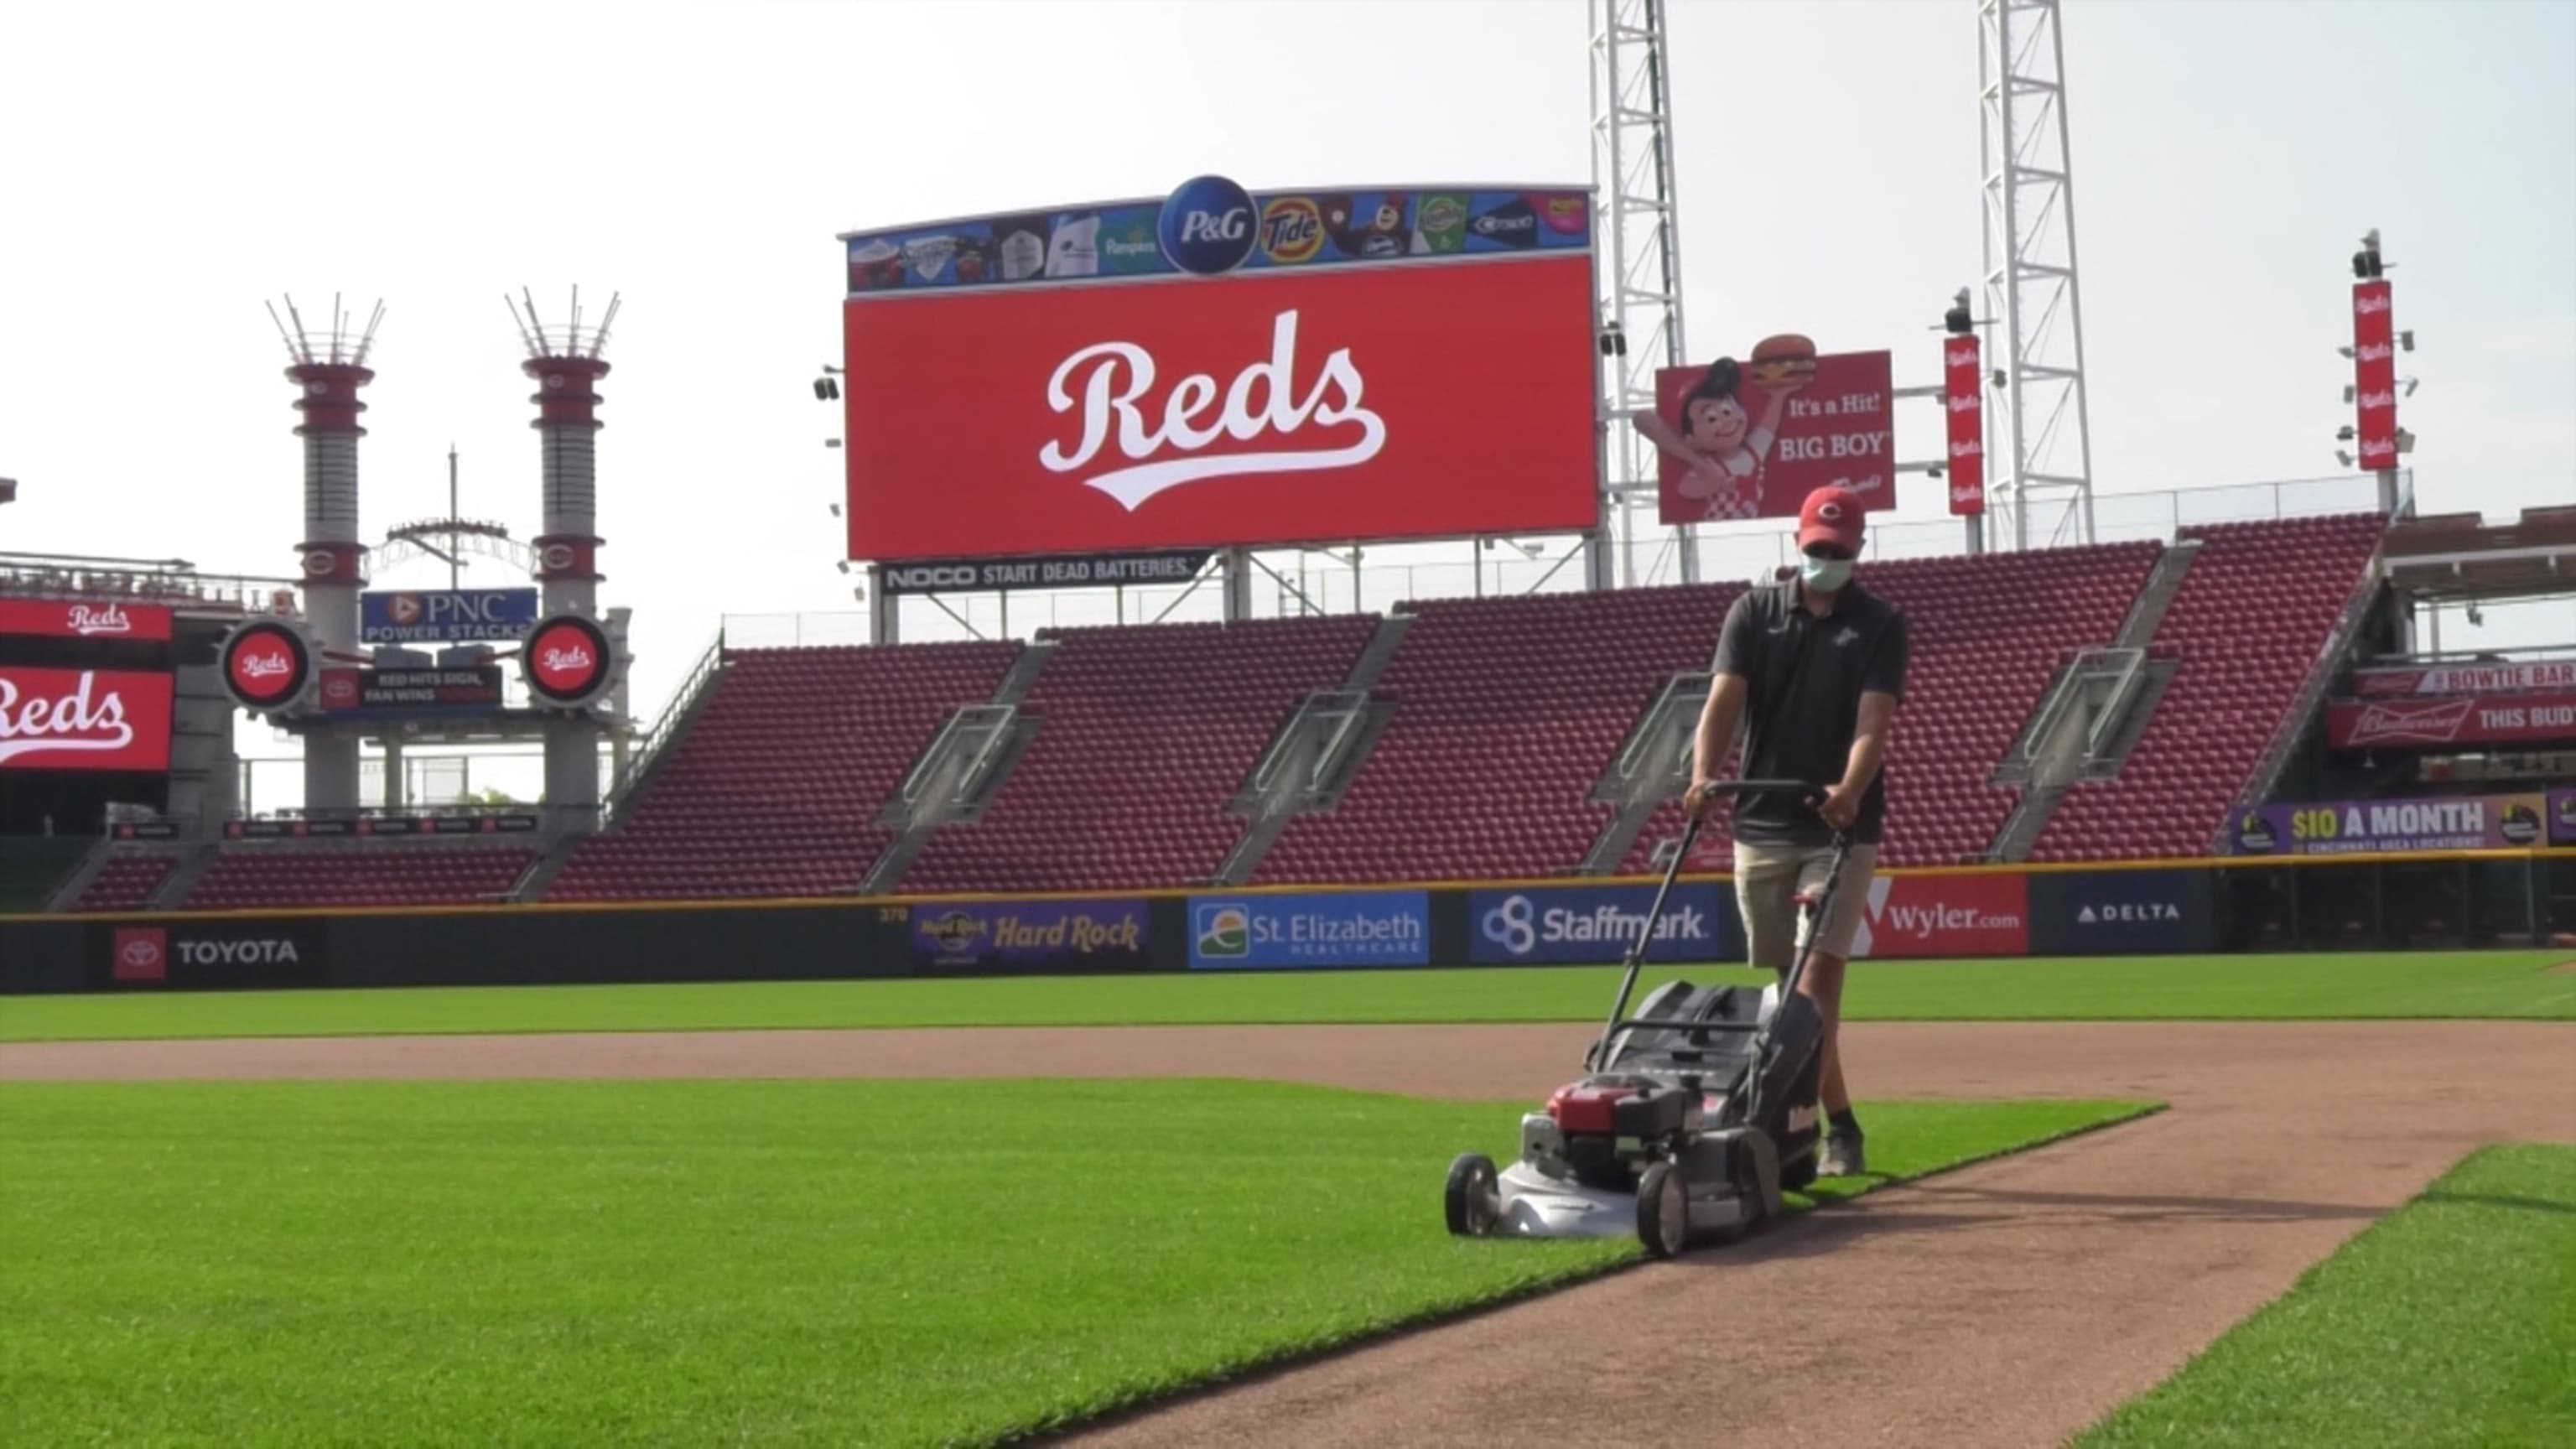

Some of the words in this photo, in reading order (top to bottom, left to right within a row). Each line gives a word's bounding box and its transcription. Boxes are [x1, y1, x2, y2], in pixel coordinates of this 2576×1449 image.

[1181, 207, 1248, 243] P&G
[1264, 213, 1318, 252] Tide
[1040, 309, 1386, 512] Reds
[1789, 397, 1820, 418] It's
[1825, 399, 1837, 414] a
[1841, 392, 1880, 413] Hit!
[1779, 435, 1825, 462] BIG
[1829, 431, 1883, 458] BOY
[887, 567, 976, 587] NOCO
[984, 563, 1036, 584] START
[1043, 561, 1089, 581] DEAD
[68, 604, 131, 636] Reds
[426, 593, 506, 622] PNC
[366, 626, 440, 641] POWER
[242, 652, 288, 677] Reds
[543, 646, 590, 671] Reds
[379, 673, 406, 686] RED
[409, 673, 441, 685] HITS
[2449, 667, 2525, 688] BOWTIE
[2533, 663, 2574, 685] BAR
[365, 689, 393, 702] FAN
[397, 688, 435, 701] WINS
[2480, 709, 2526, 729] THIS
[2292, 808, 2337, 839] $10
[2345, 807, 2365, 836] A
[2371, 802, 2484, 835] MONTH
[1541, 905, 1704, 942] Staffmark
[1889, 902, 2019, 938] Wyler.com
[2102, 903, 2180, 921] DELTA
[994, 916, 1068, 948] Hard
[1071, 914, 1140, 953] Rock
[1291, 911, 1421, 942] Elizabeth
[176, 940, 299, 964] TOYOTA
[1291, 941, 1420, 956] HEALTHCARE
